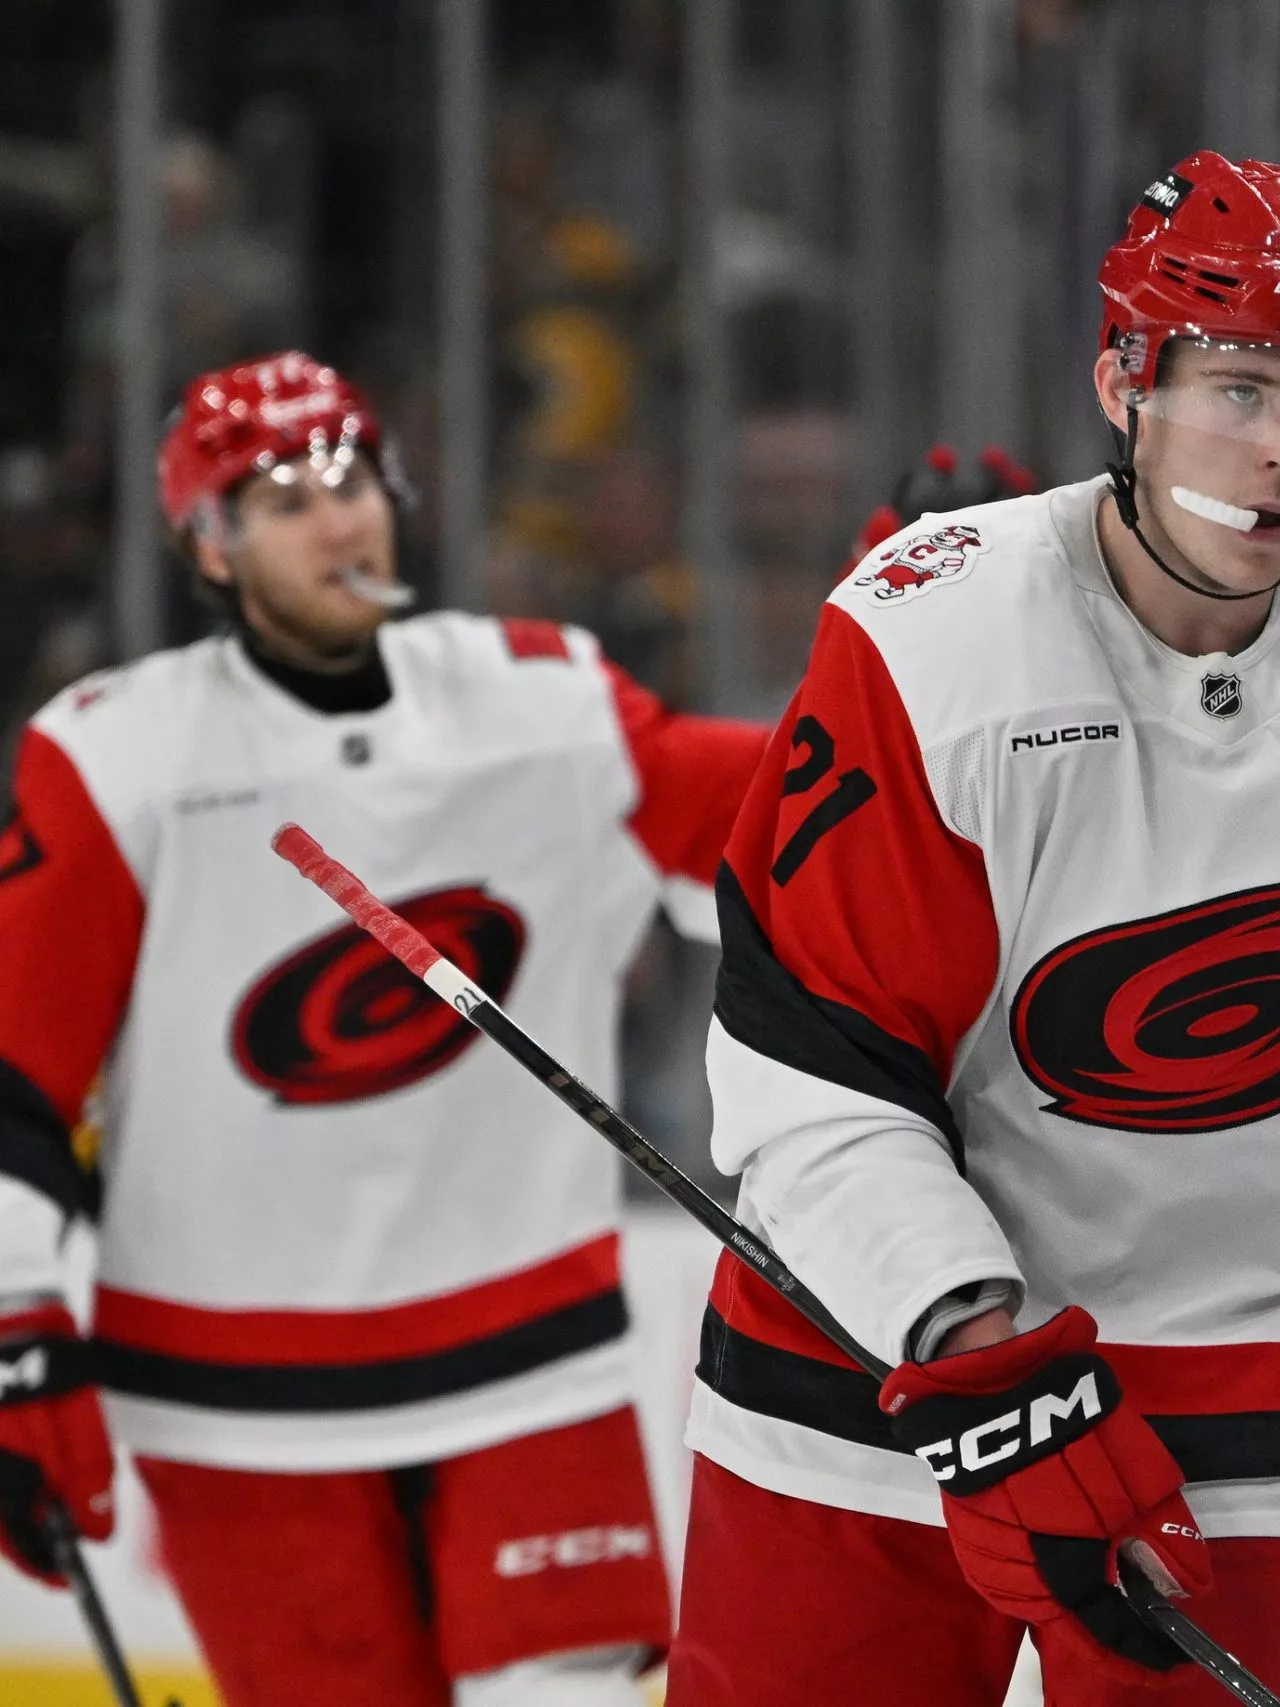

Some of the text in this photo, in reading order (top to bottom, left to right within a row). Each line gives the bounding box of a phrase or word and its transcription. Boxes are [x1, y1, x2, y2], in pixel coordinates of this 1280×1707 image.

[1210, 685, 1235, 711] NHL
[1011, 724, 1119, 752] NUCOR
[769, 715, 877, 888] 21
[731, 1232, 769, 1268] NIKISHIN
[915, 1371, 1102, 1481] CCM
